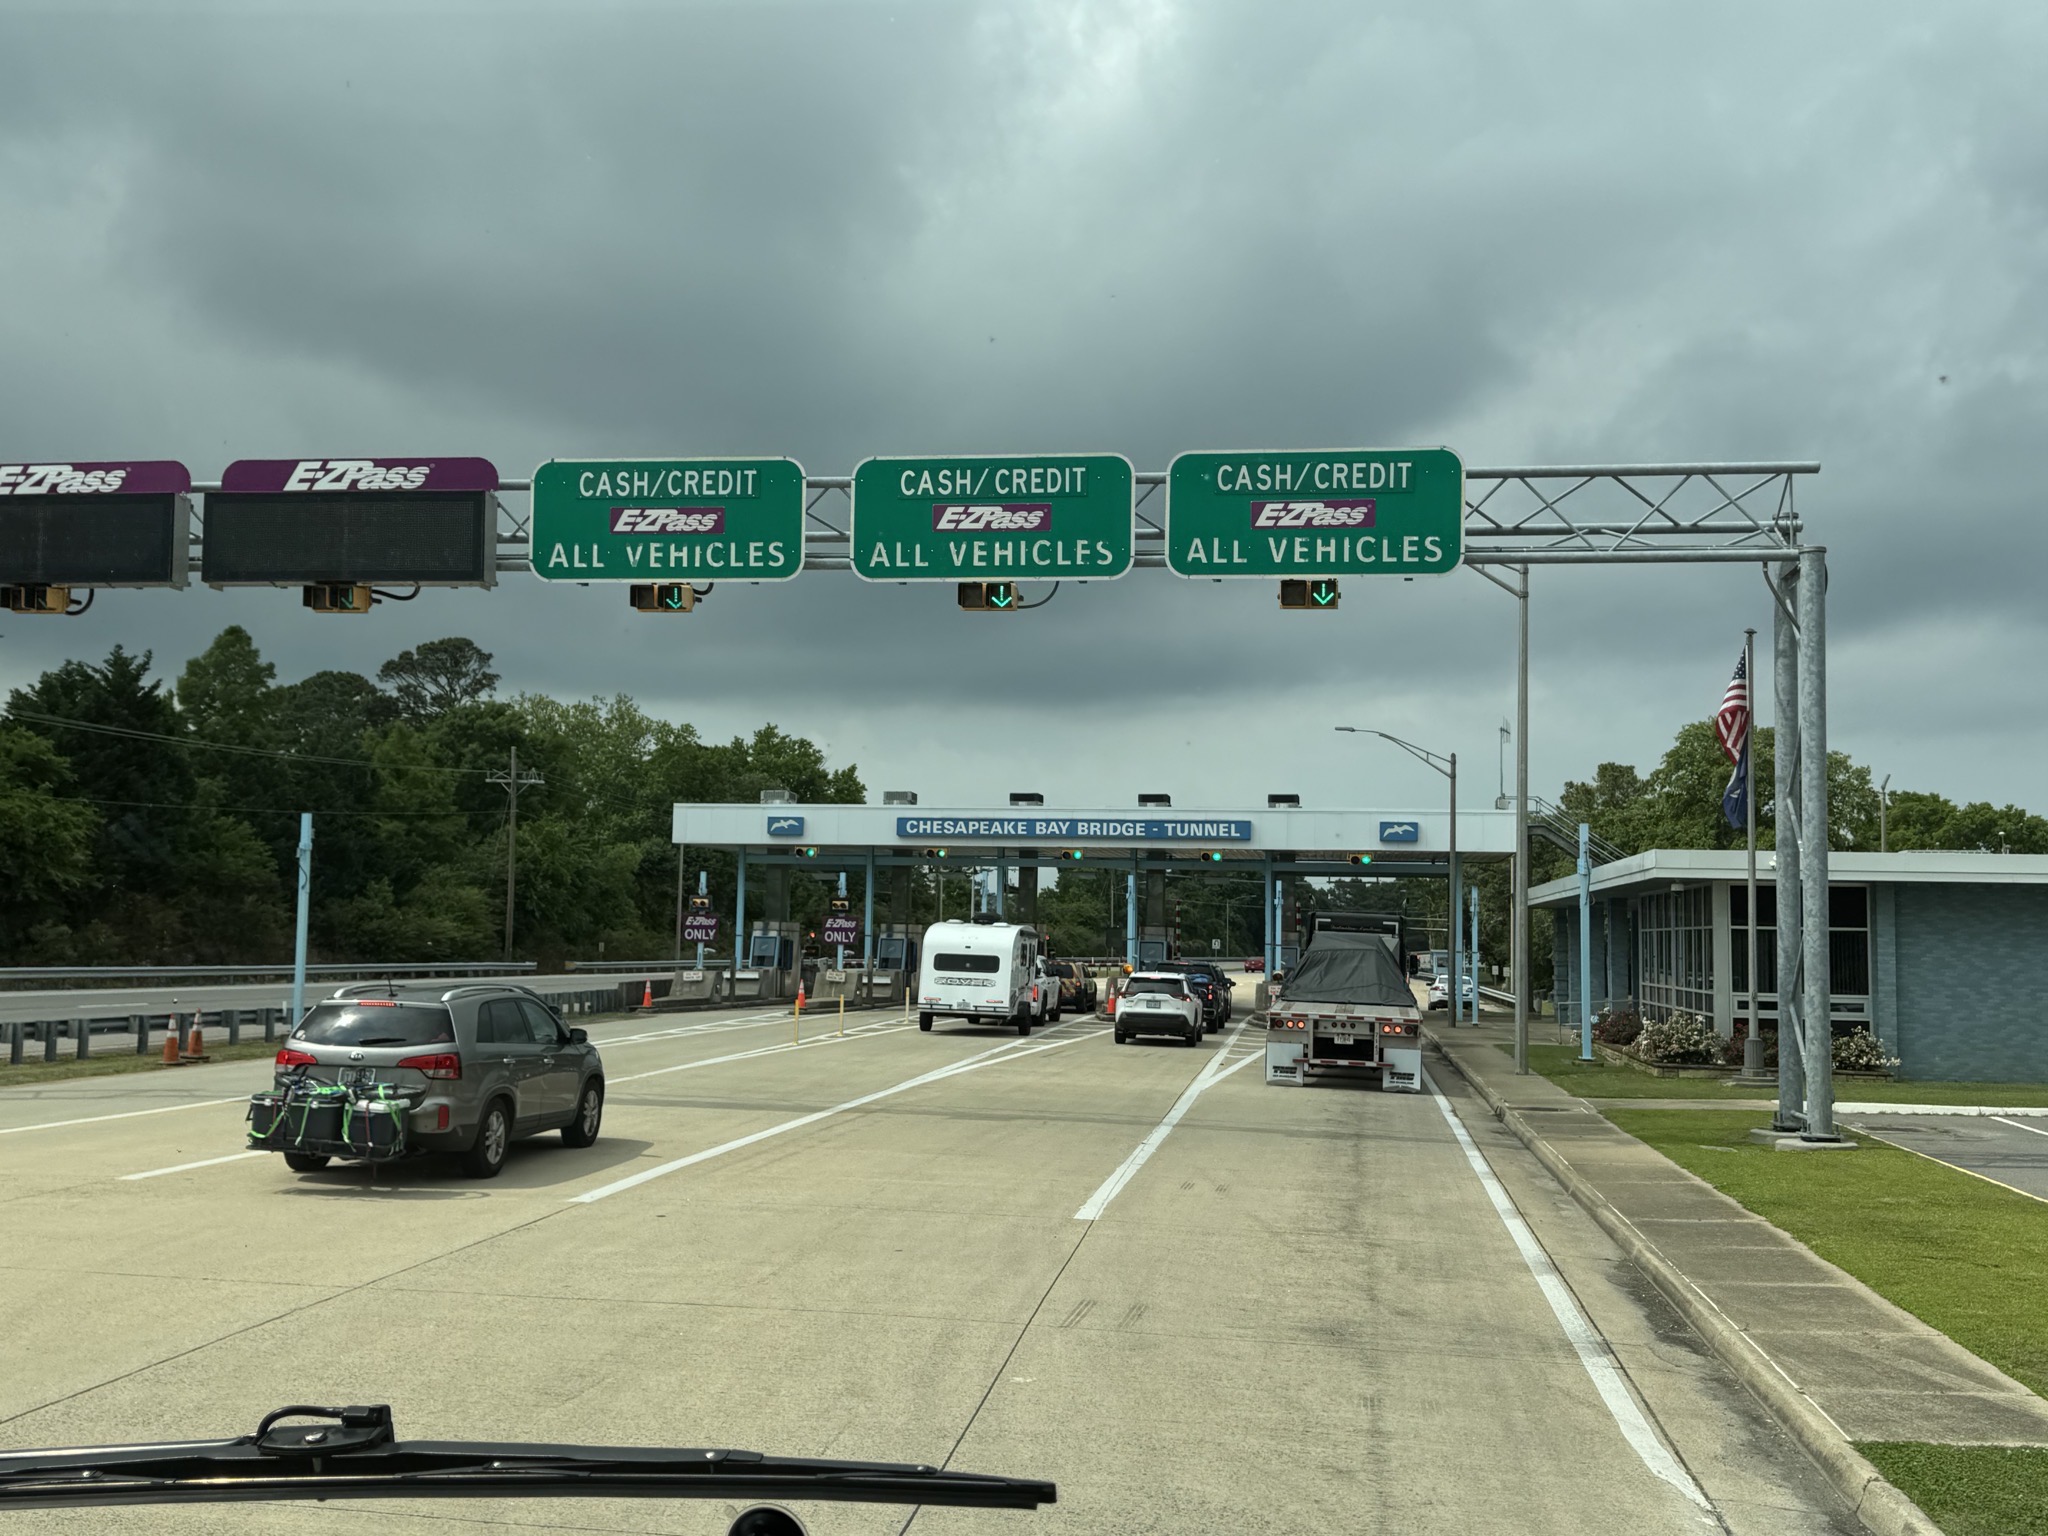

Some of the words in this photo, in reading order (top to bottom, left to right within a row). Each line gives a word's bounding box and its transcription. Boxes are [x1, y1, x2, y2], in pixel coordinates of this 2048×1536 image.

[282, 460, 431, 493] E-ZPass
[579, 470, 757, 497] CASH/CREDIT
[1217, 462, 1412, 491] CASH/CREDIT
[613, 508, 719, 532] E-ZPass
[936, 506, 1045, 530] E-ZPass
[1255, 502, 1368, 527] E-ZPass
[547, 542, 606, 569] ALL
[625, 541, 786, 568] VEHICLES
[868, 541, 930, 569] ALL
[1186, 537, 1248, 564] ALL
[1267, 535, 1443, 564] VEHICLES
[905, 820, 1028, 835] CHESAPEAKE
[1034, 820, 1071, 836] BAY
[1077, 822, 1146, 837] BRIDGE
[1164, 823, 1241, 838] TUNNEL
[684, 928, 716, 940] ONLY
[824, 930, 856, 943] ONLY
